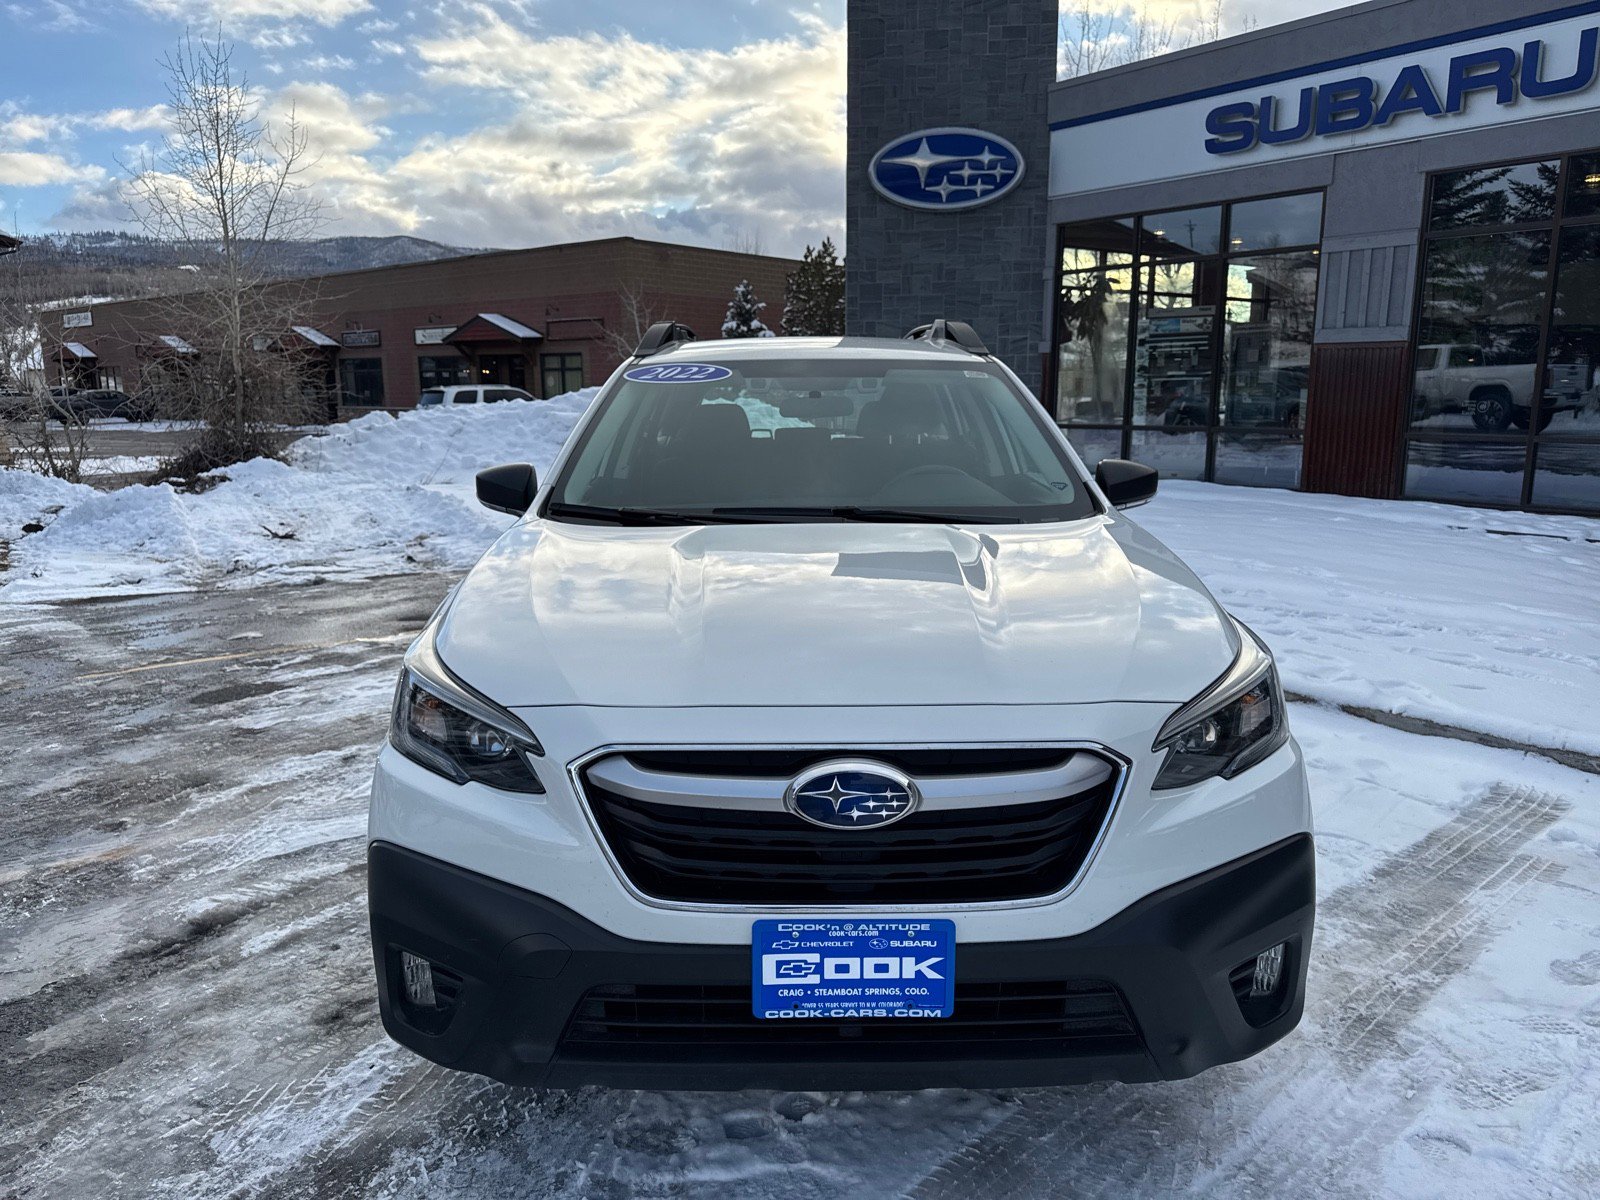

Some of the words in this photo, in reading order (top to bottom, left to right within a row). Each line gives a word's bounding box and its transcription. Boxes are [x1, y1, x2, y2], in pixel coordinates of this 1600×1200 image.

[1205, 26, 1599, 155] SUBARU
[638, 366, 716, 379] 2022
[843, 923, 855, 931] @
[857, 923, 931, 931] ALTITUDE
[762, 953, 946, 986] COOK
[778, 988, 804, 996] CRAIG
[814, 988, 862, 996] STEAMBOAT
[864, 987, 903, 996] SPRINGS,
[904, 987, 930, 995] COLO.
[765, 1009, 942, 1019] COOK-CARS.COM
